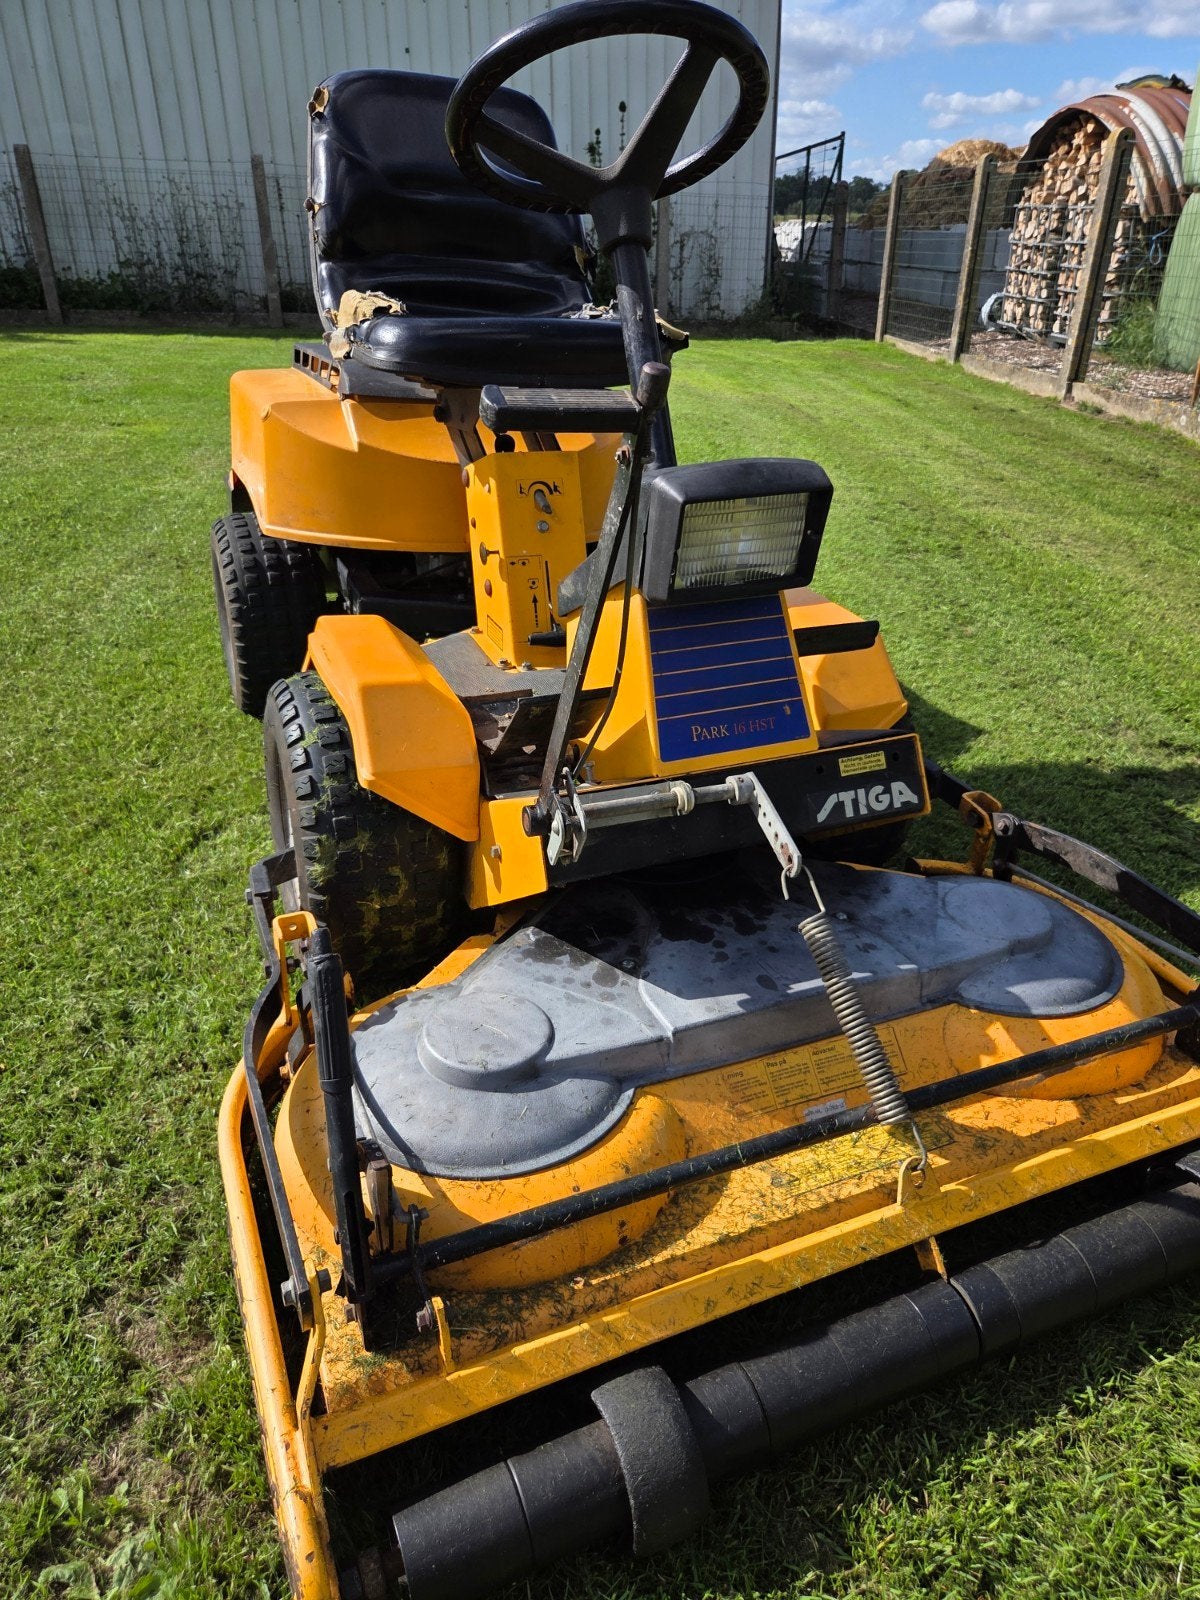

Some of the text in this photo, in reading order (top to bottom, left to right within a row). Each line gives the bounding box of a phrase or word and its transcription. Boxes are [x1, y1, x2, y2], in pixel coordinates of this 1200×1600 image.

[733, 722, 746, 735] 16
[749, 717, 776, 732] HST
[816, 781, 919, 823] STIGA
